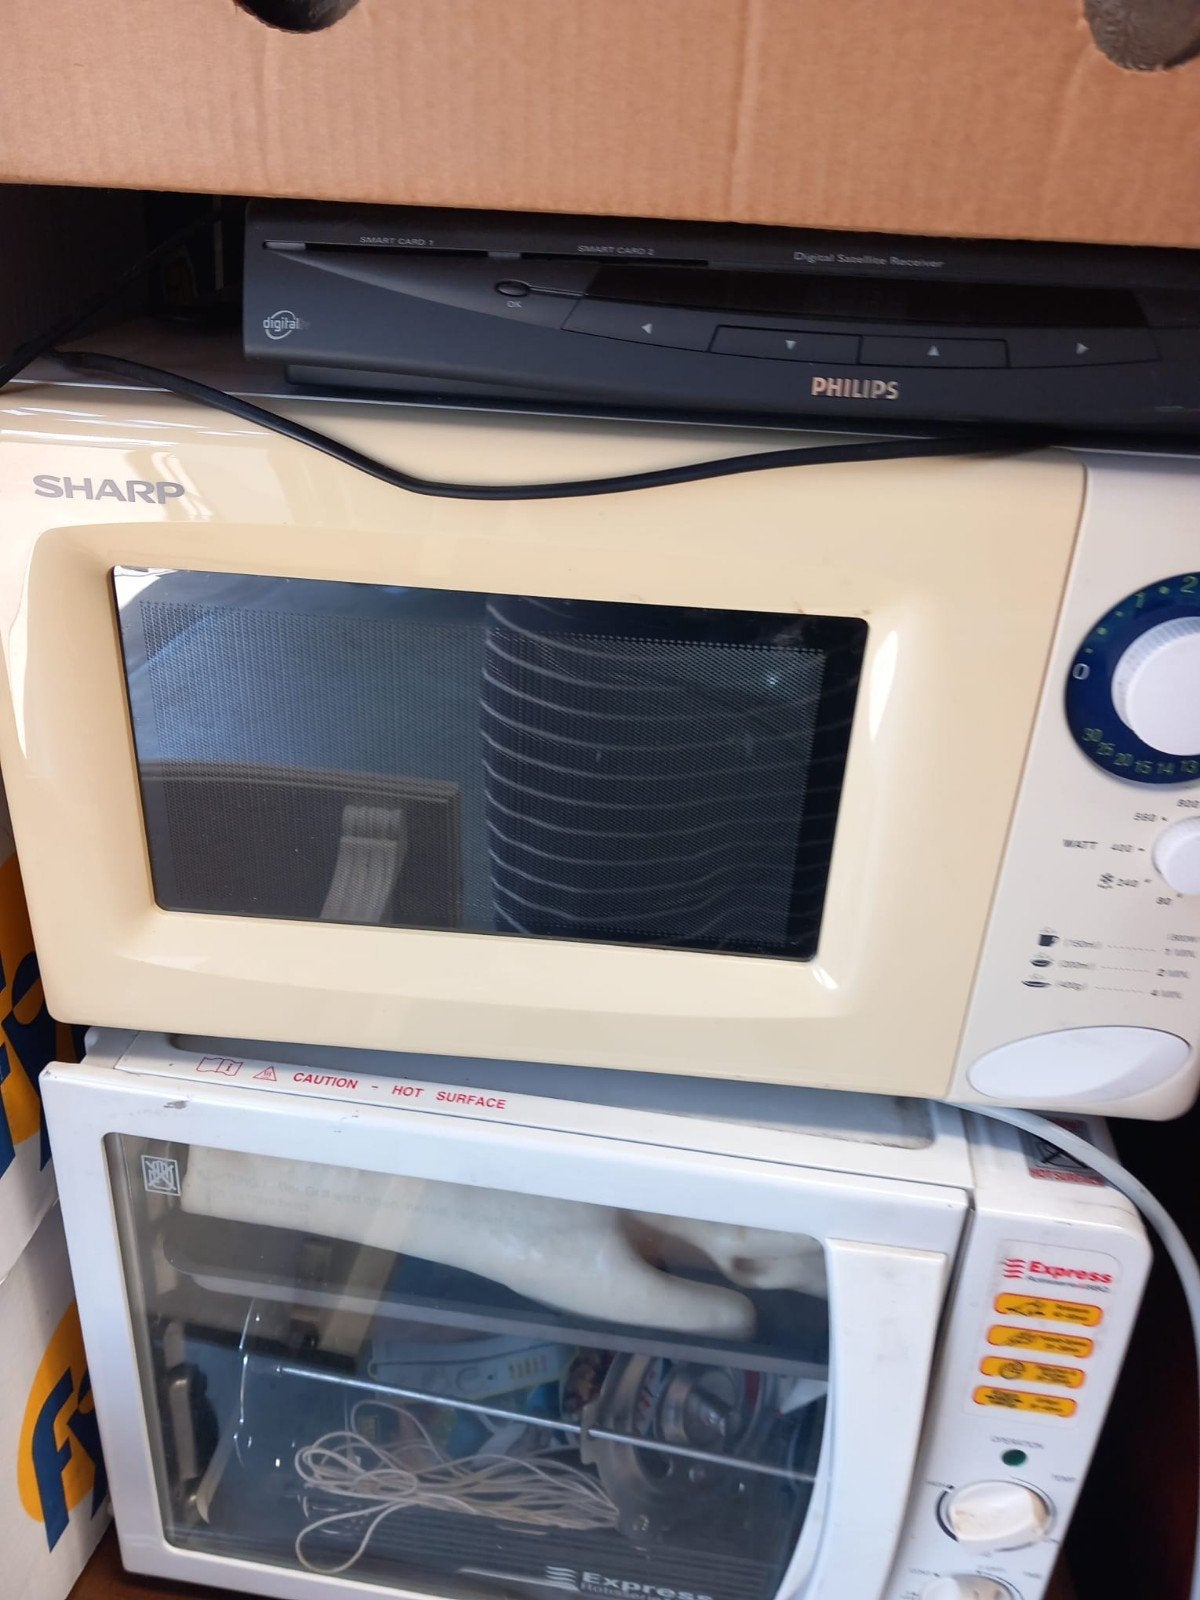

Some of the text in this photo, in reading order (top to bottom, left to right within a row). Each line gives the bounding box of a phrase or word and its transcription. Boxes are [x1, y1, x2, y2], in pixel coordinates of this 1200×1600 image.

[359, 236, 395, 245] SMART
[397, 237, 427, 246] CARD
[577, 245, 613, 253] SMART
[615, 246, 646, 255] CARD
[793, 251, 945, 267] Digital Satellite Receiver
[506, 300, 522, 308] OK
[263, 316, 301, 332] digital
[811, 376, 899, 400] PHILIPS
[33, 474, 185, 505] SHARP
[1180, 575, 1199, 594] 2
[1135, 591, 1146, 609] 1
[1072, 662, 1091, 680] 0
[293, 1072, 358, 1089] CAUTION
[392, 1085, 424, 1097] HOT
[436, 1091, 507, 1110] SURFACE
[1029, 1261, 1113, 1284] Express
